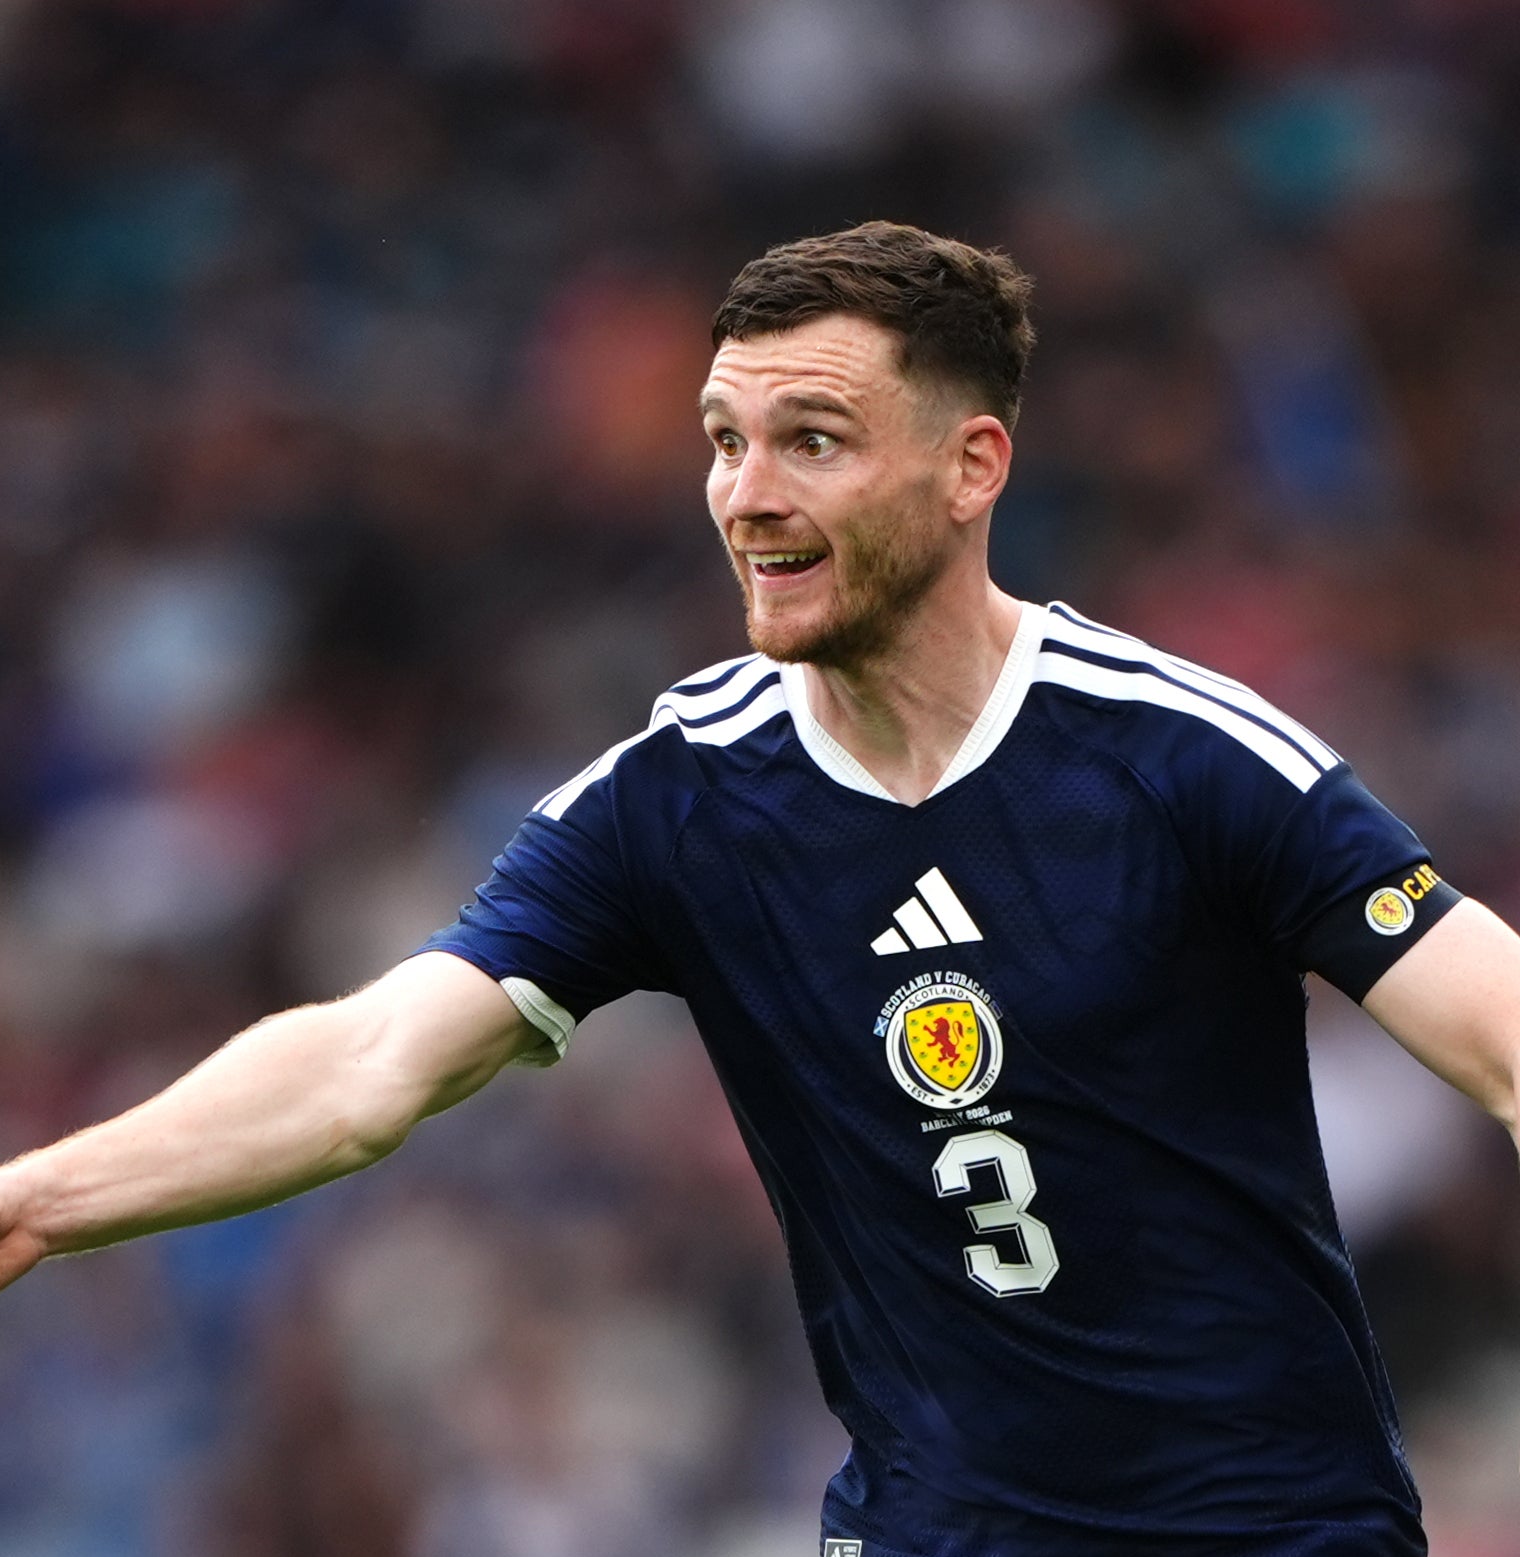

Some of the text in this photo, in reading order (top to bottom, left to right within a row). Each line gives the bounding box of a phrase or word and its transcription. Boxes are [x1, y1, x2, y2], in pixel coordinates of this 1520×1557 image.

[1402, 864, 1442, 900] CAP
[881, 972, 932, 1018] SCOTLAND
[934, 971, 942, 983] V
[909, 987, 964, 1007] SCOTLAND
[911, 1072, 995, 1101] EST 1873
[921, 1117, 967, 1133] BARCLA
[969, 1110, 1013, 1127] MPDEN
[965, 1105, 990, 1120] 2026
[932, 1130, 1060, 1298] 3
